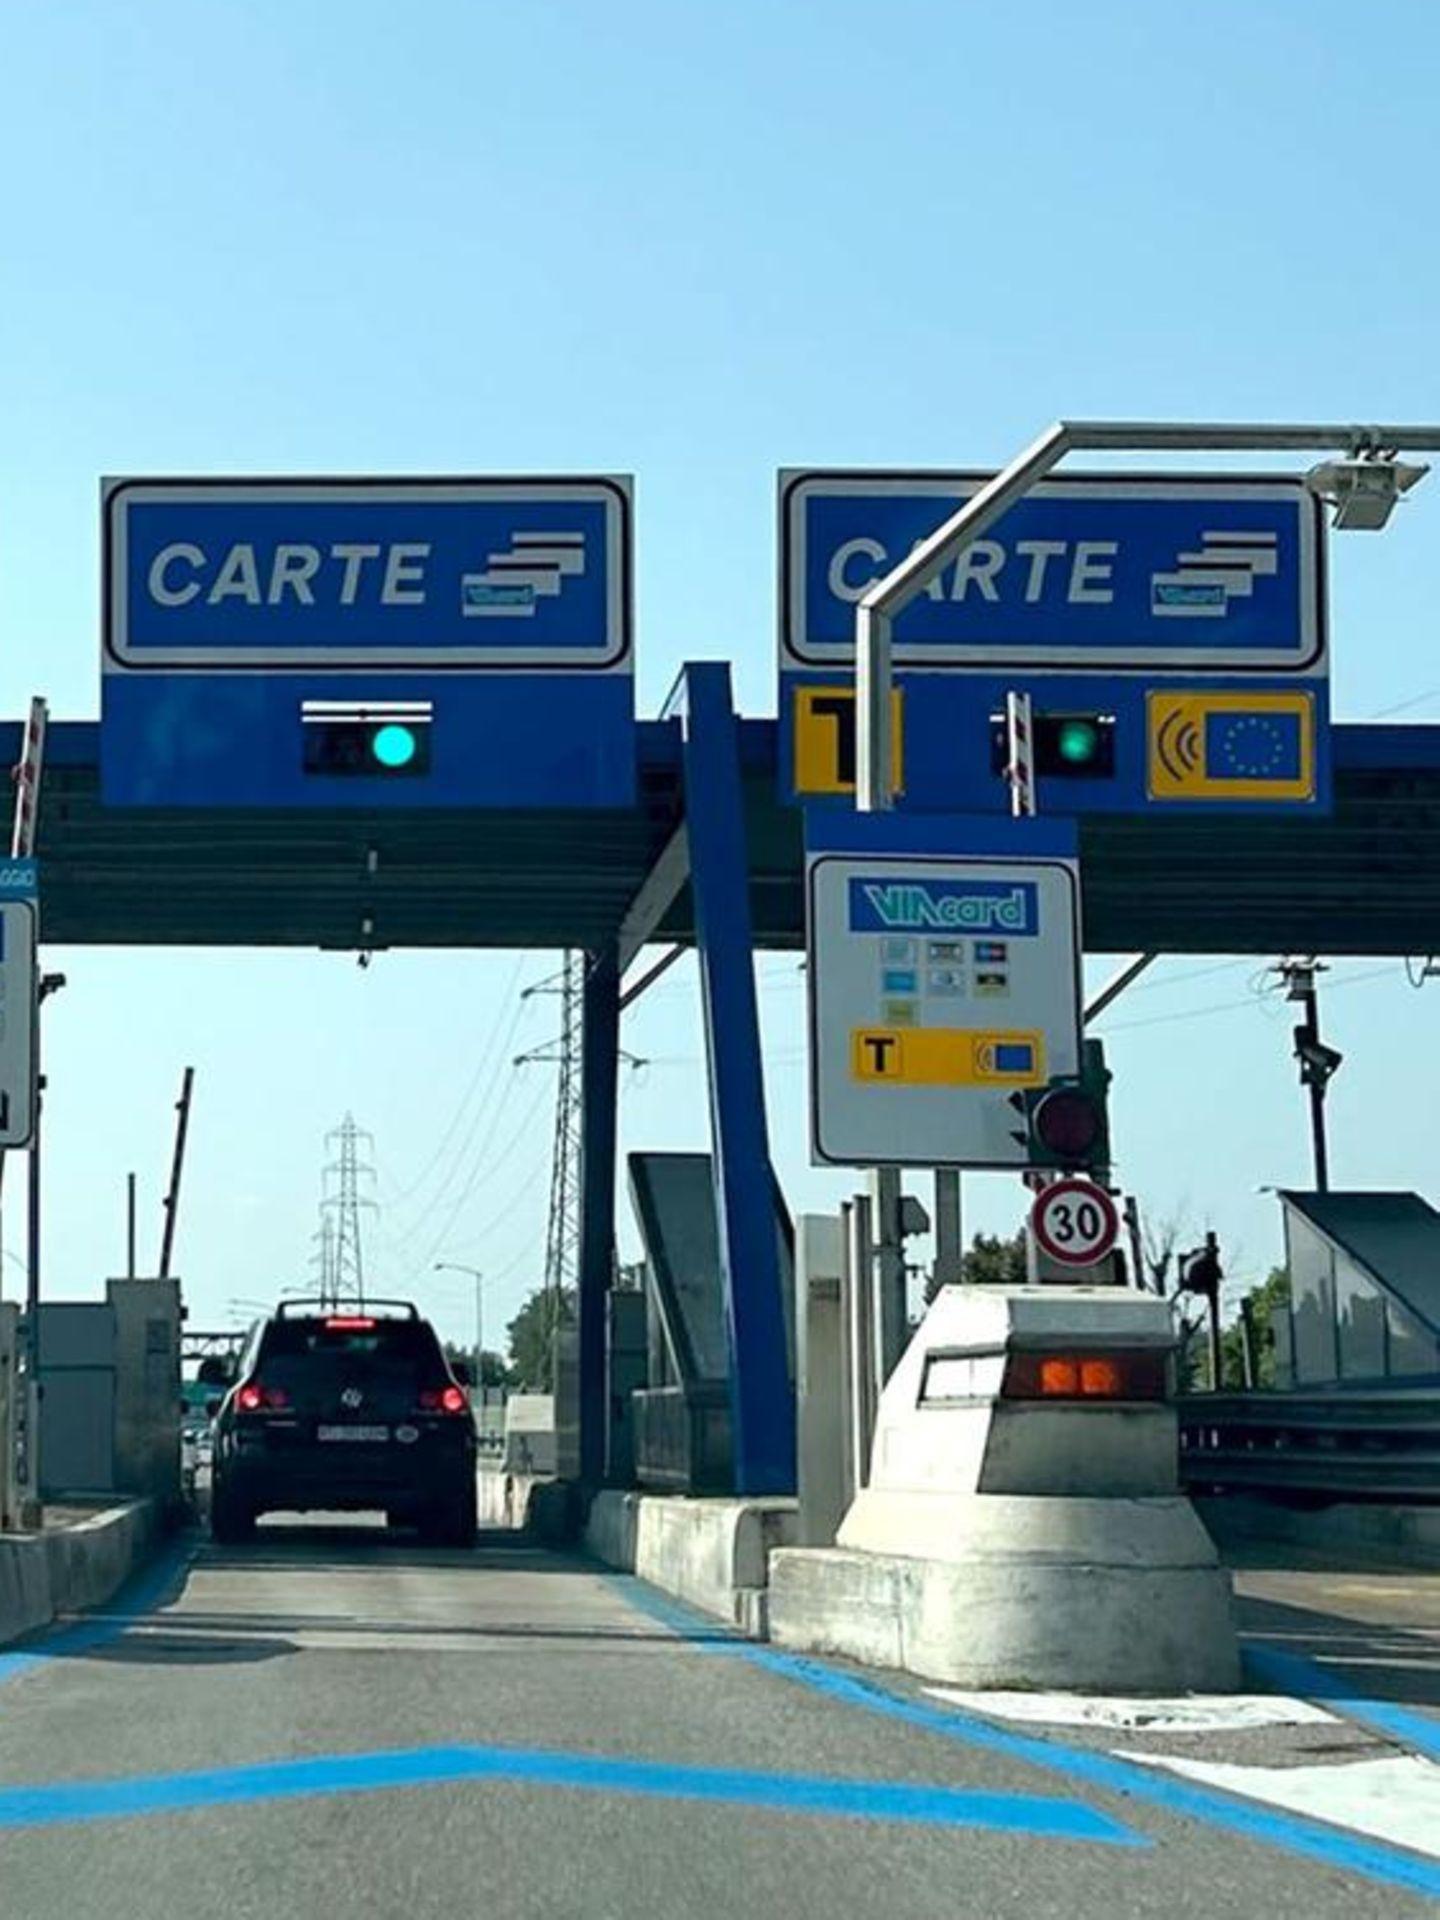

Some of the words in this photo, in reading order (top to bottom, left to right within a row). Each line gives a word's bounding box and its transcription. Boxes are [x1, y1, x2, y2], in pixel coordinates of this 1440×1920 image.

[148, 542, 432, 606] CARTE
[828, 536, 1118, 603] CRTE
[865, 1037, 894, 1073] T
[1052, 1203, 1101, 1243] 30
